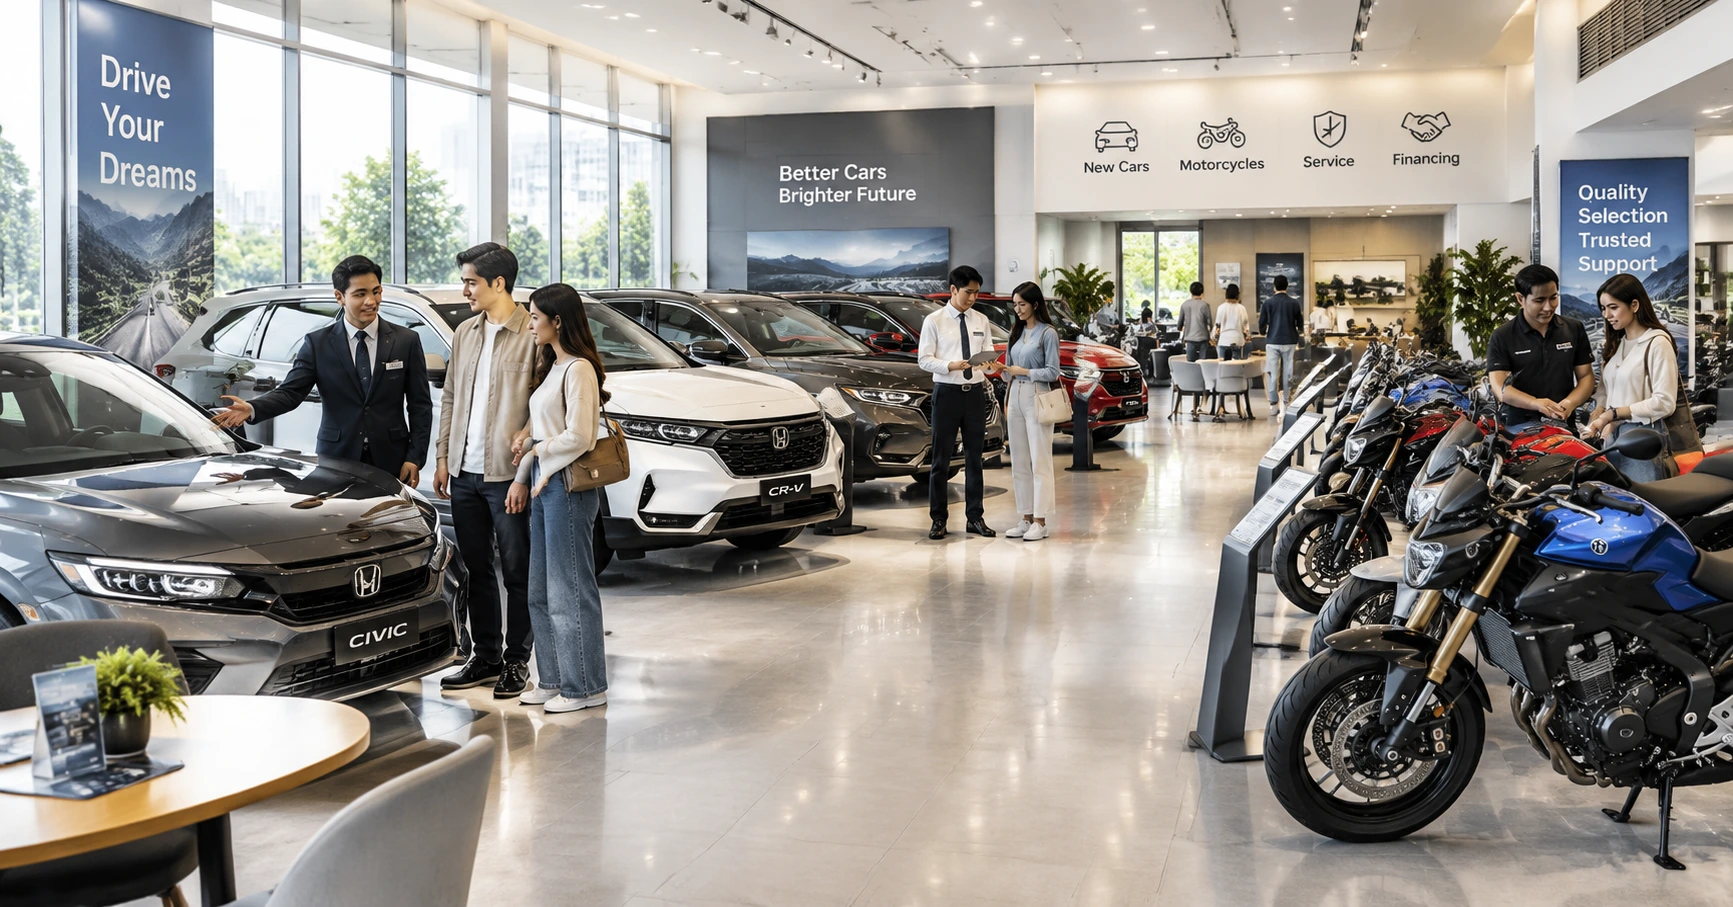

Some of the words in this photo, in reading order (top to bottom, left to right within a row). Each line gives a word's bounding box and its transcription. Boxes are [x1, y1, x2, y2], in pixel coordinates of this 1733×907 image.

[101, 53, 171, 99] Drive
[100, 102, 164, 143] Your
[1084, 161, 1115, 174] New
[1118, 160, 1150, 173] Cars
[1179, 157, 1265, 173] Motorcycles
[1303, 155, 1355, 168] Service
[1392, 151, 1460, 168] Financing
[100, 151, 197, 192] Dreams
[779, 165, 840, 182] Better
[844, 163, 887, 180] Cars
[779, 186, 853, 207] Brighter
[857, 186, 917, 202] Future
[1578, 183, 1648, 204] Quality
[1578, 207, 1668, 224] Selection
[1578, 231, 1651, 248] Trusted
[1578, 255, 1658, 275] Support
[768, 483, 804, 497] CR-V
[349, 622, 408, 648] CIVIC
